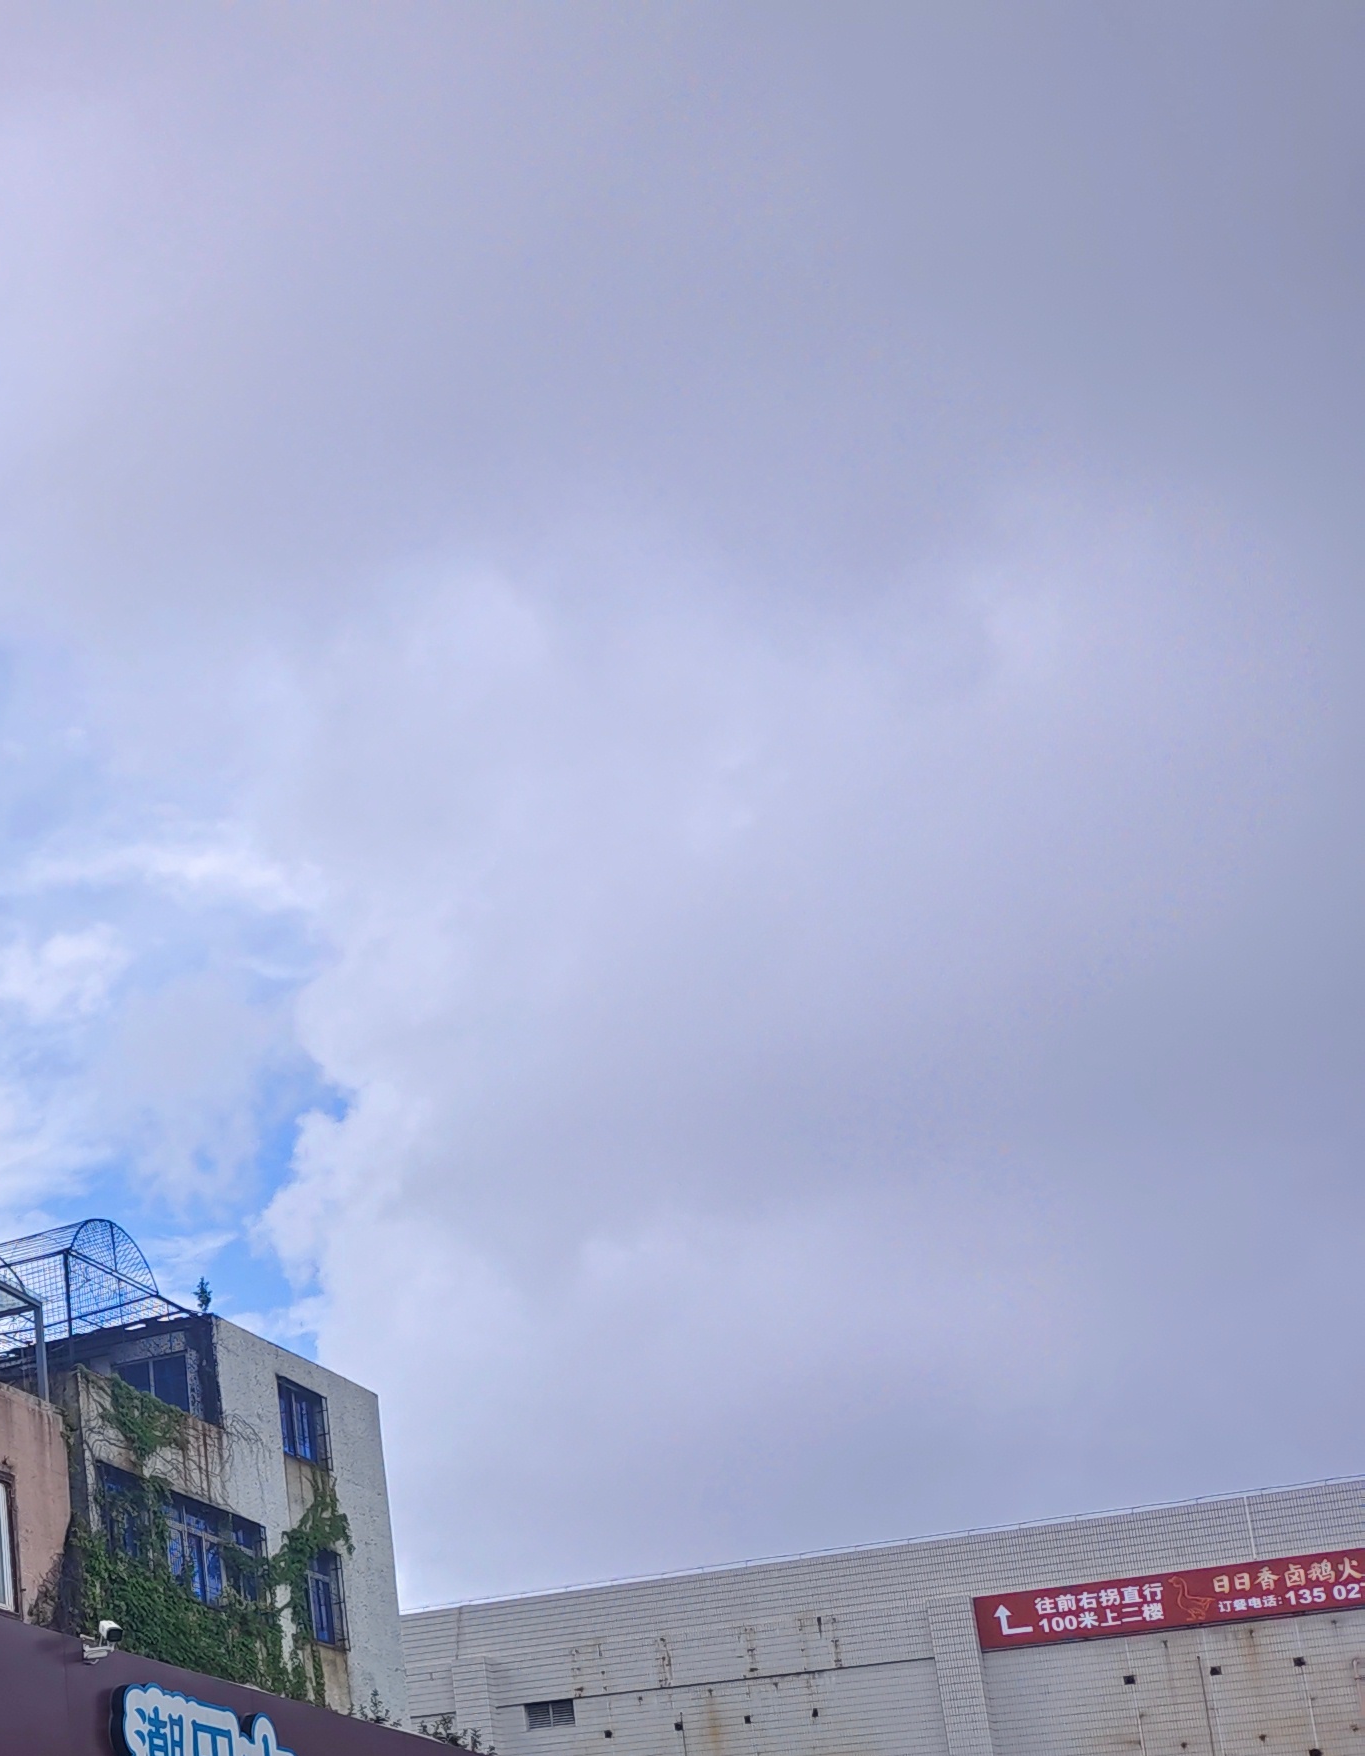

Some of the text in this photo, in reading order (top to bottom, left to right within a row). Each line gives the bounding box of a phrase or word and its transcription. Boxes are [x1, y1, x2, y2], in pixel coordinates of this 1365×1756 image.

[1212, 1556, 1365, 1594] 日日香卤鹅火
[1034, 1582, 1164, 1615] 往前右拐直行
[1285, 1587, 1327, 1606] 135
[1332, 1582, 1365, 1601] 02
[1038, 1602, 1165, 1633] 100米上二楼
